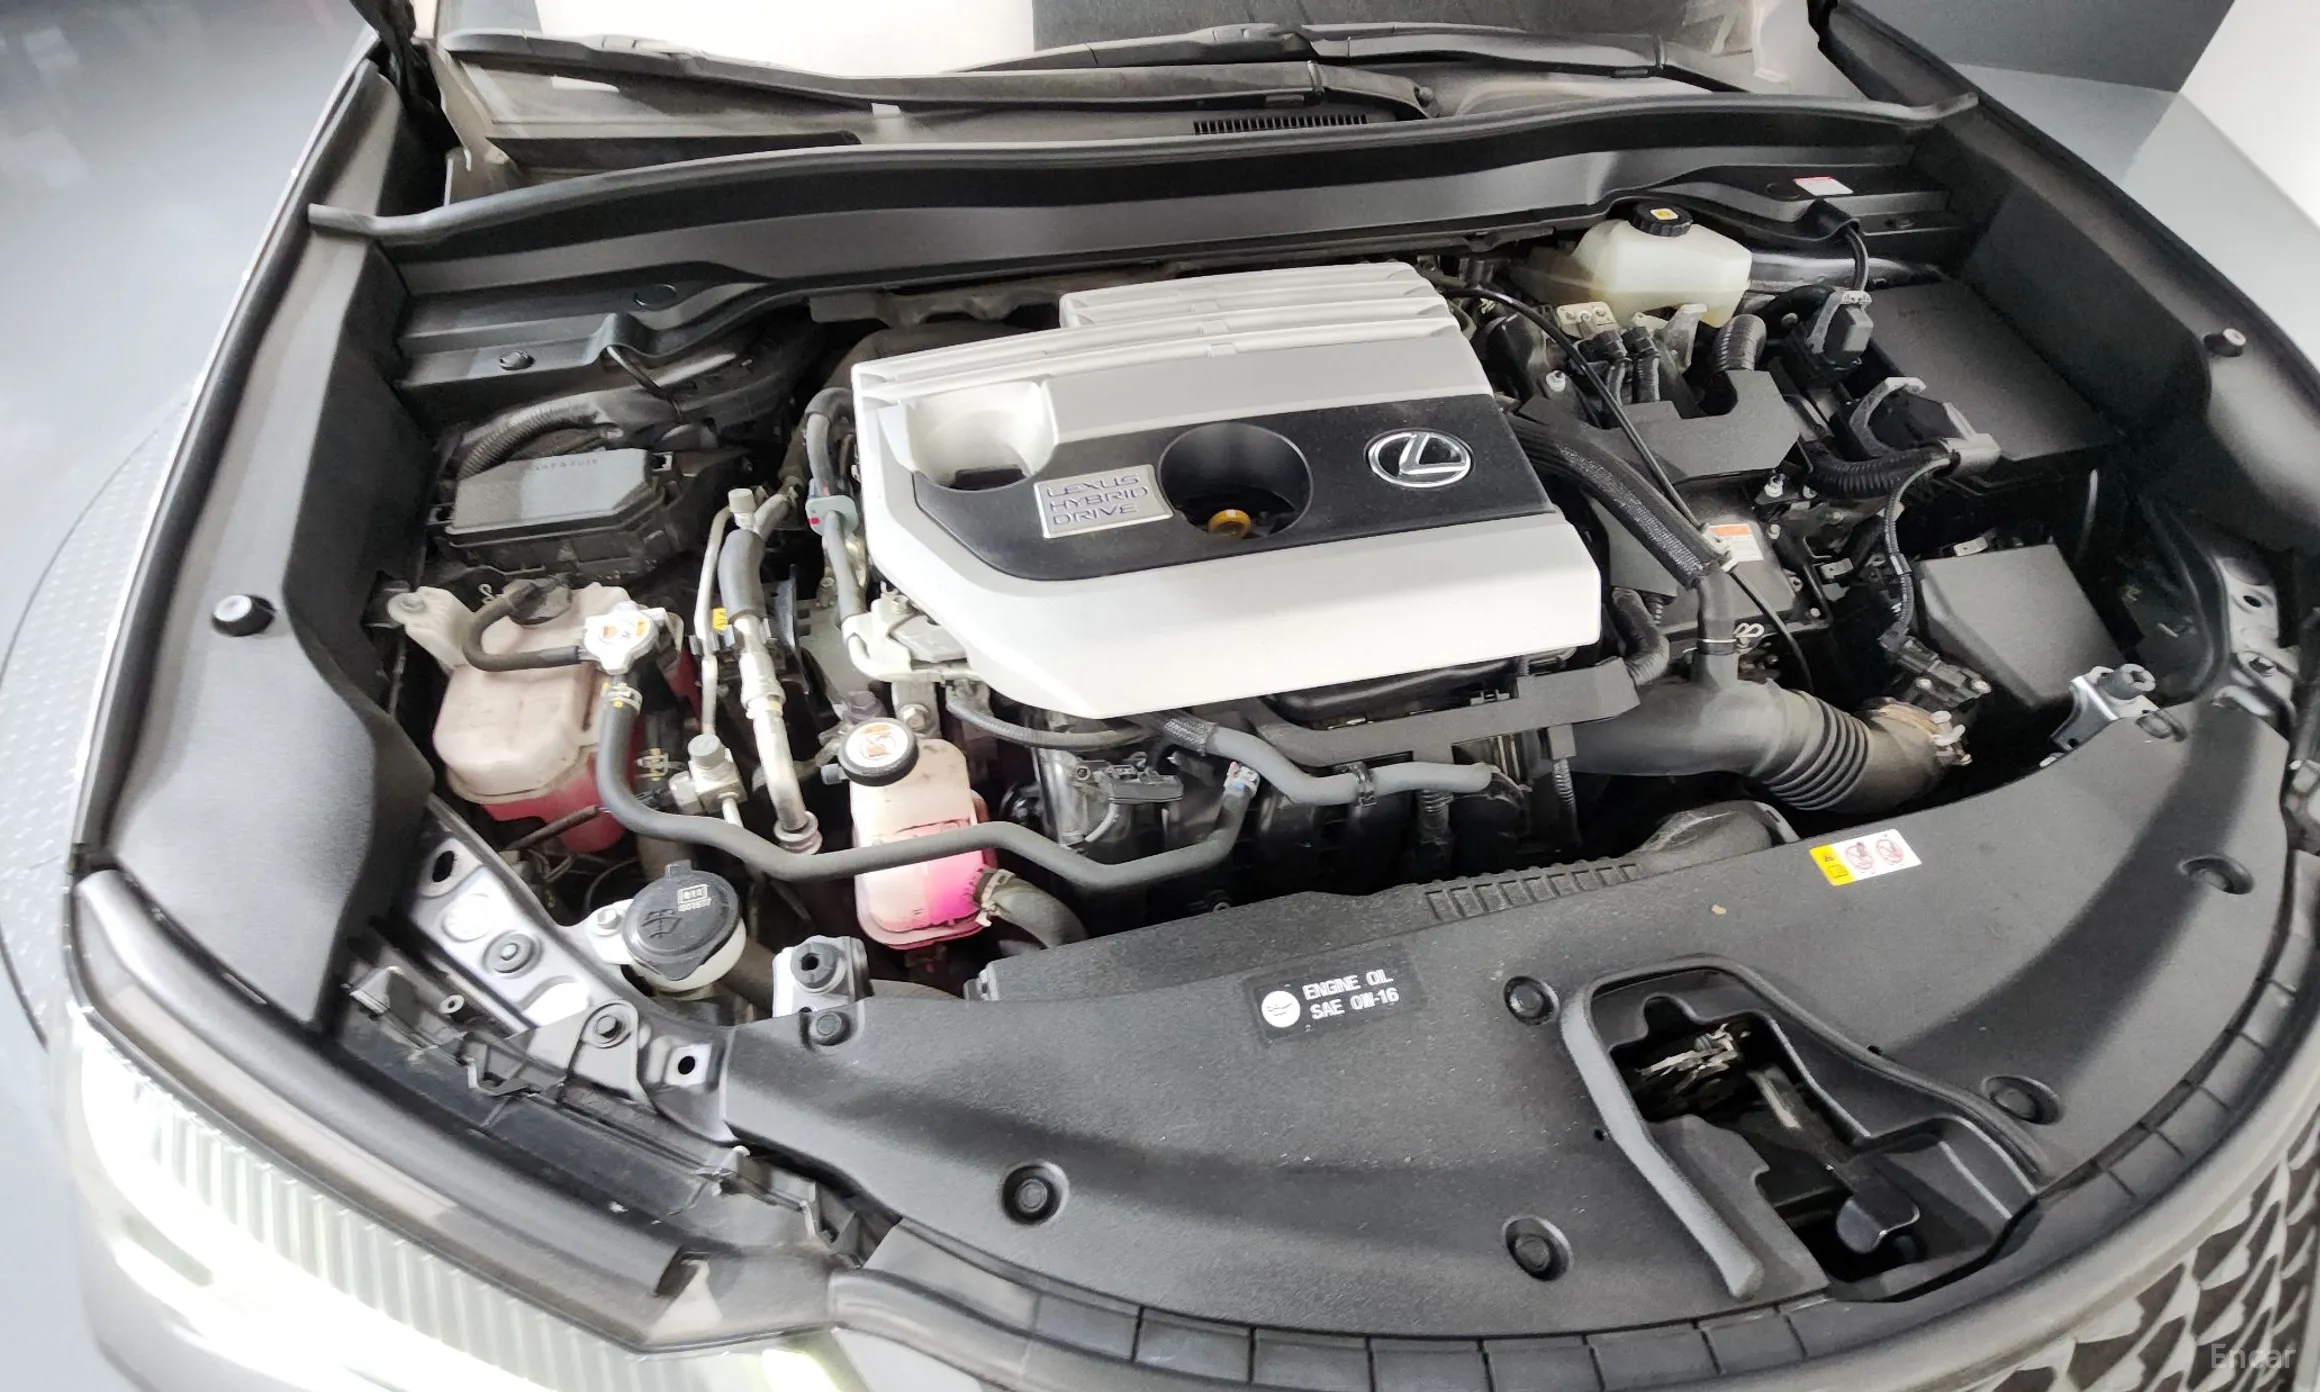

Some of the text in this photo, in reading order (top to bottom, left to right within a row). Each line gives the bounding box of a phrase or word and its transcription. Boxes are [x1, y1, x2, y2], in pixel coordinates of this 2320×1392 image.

[1046, 475, 1139, 497] LEXUS
[1050, 487, 1148, 512] HYBRID
[1053, 502, 1138, 526] DRIVE
[1302, 969, 1394, 1000] ENGINE OIL
[1310, 987, 1400, 1020] SAE 0W-16
